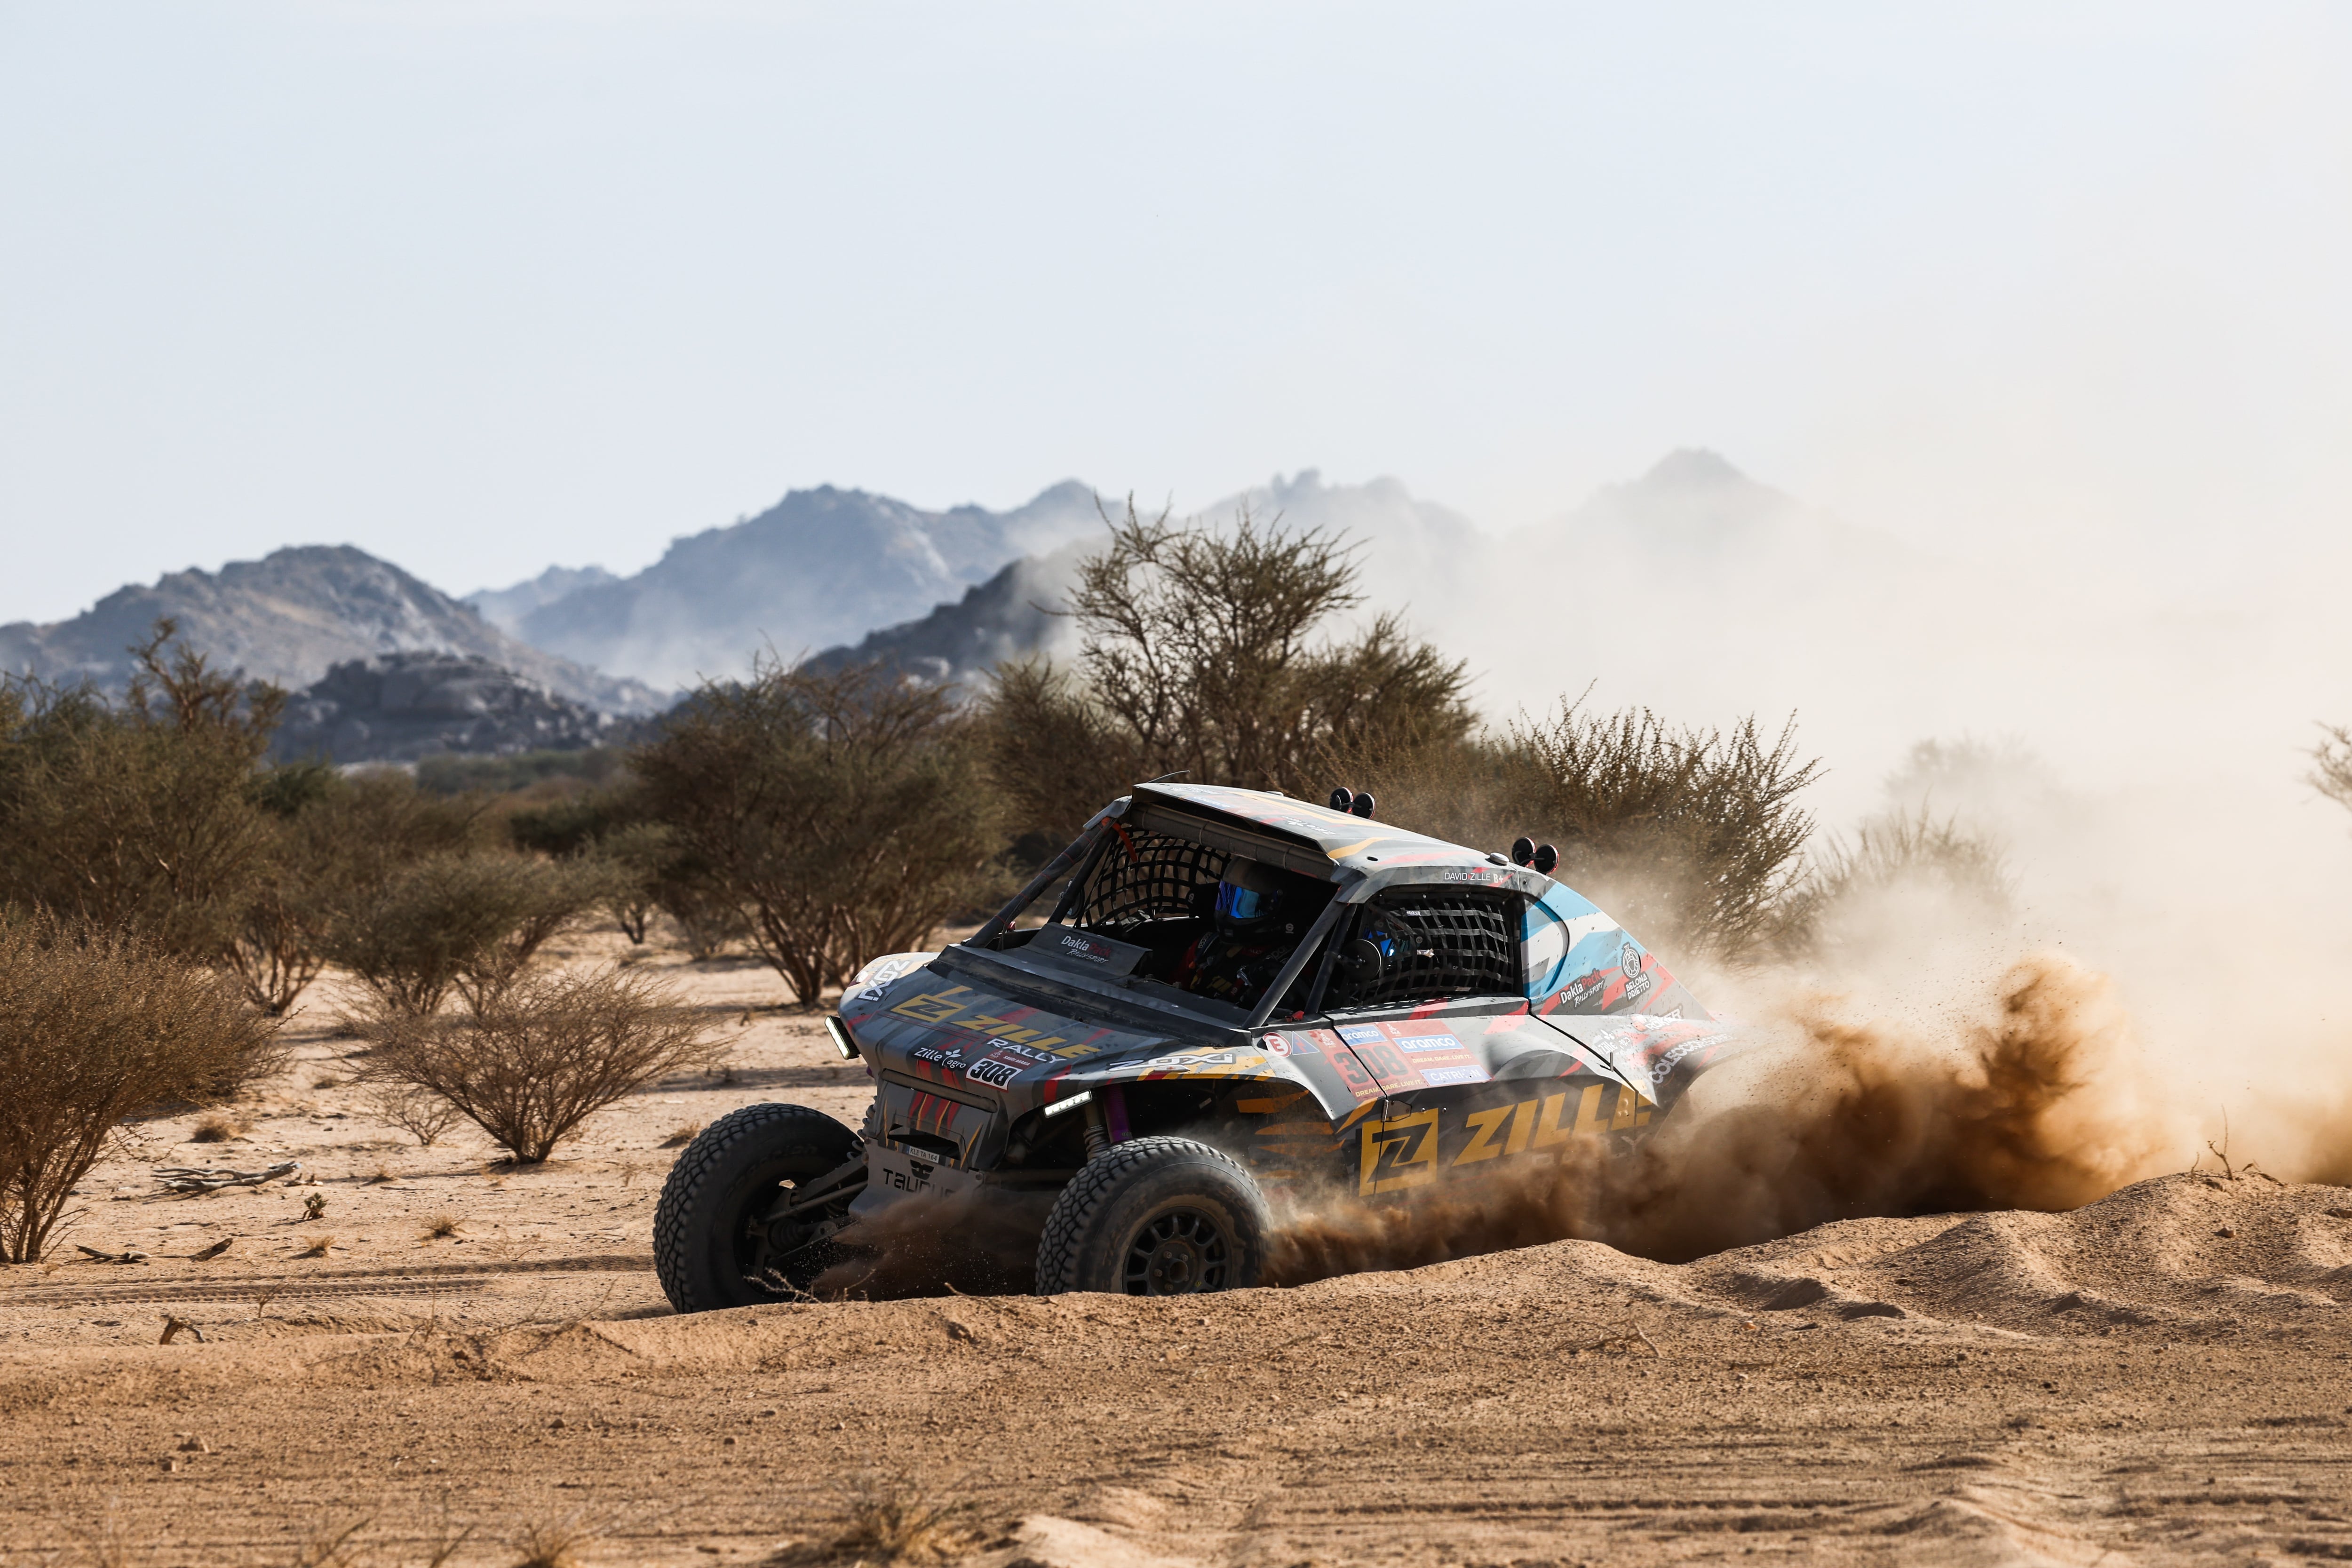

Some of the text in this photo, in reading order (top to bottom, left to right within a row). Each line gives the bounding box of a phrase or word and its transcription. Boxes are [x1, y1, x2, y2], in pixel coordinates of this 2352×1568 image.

[1493, 874, 1504, 883] B+
[1066, 949, 1089, 958] RALLY
[1574, 980, 1604, 1007] RALLY SPORT
[1626, 973, 1648, 992] BELONA
[950, 1014, 1103, 1059] ZILLE
[1269, 1038, 1285, 1052] E
[1402, 1037, 1455, 1049] aramco
[914, 1047, 966, 1069] Zille agro
[987, 1038, 1067, 1064] RALLY
[969, 1060, 1017, 1087] 308
[1334, 1045, 1409, 1084] 308
[1451, 1081, 1653, 1167] ZILLE
[910, 1147, 919, 1156] KLE
[928, 1153, 938, 1162] 164
